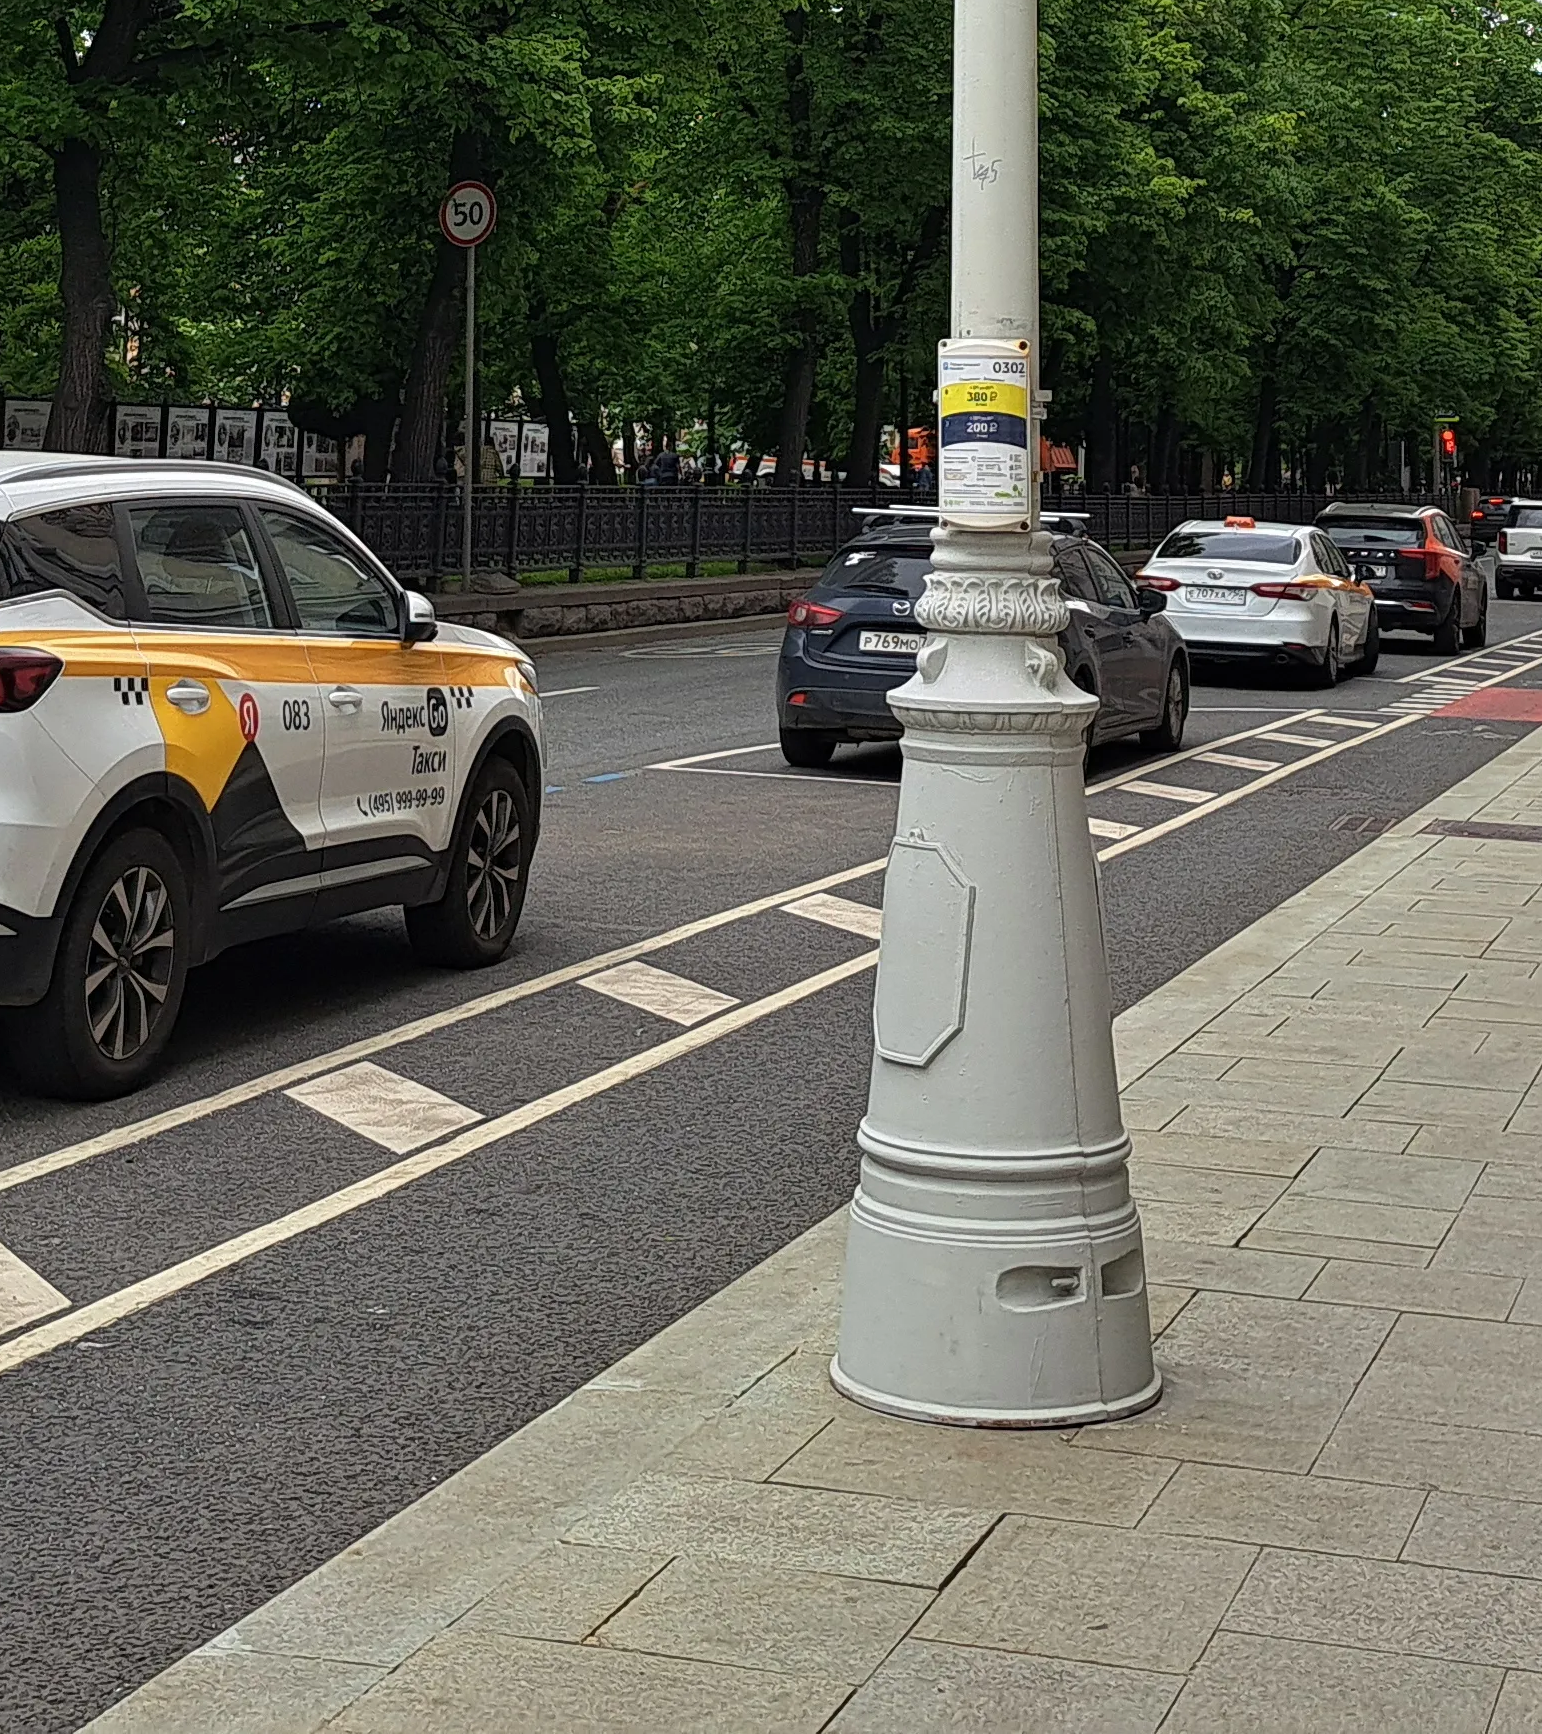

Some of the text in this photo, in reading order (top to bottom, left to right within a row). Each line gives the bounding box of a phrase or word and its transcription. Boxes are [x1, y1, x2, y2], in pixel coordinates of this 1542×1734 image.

[452, 200, 484, 227] 50
[992, 361, 1026, 374] 0302
[966, 391, 988, 402] 380
[966, 422, 988, 433] 200
[863, 633, 919, 651] Р769МО
[243, 701, 254, 735] Я
[282, 699, 311, 731] 083
[380, 700, 426, 735] Яндекс
[411, 745, 447, 775] Такси
[395, 786, 445, 814] 999-99-99
